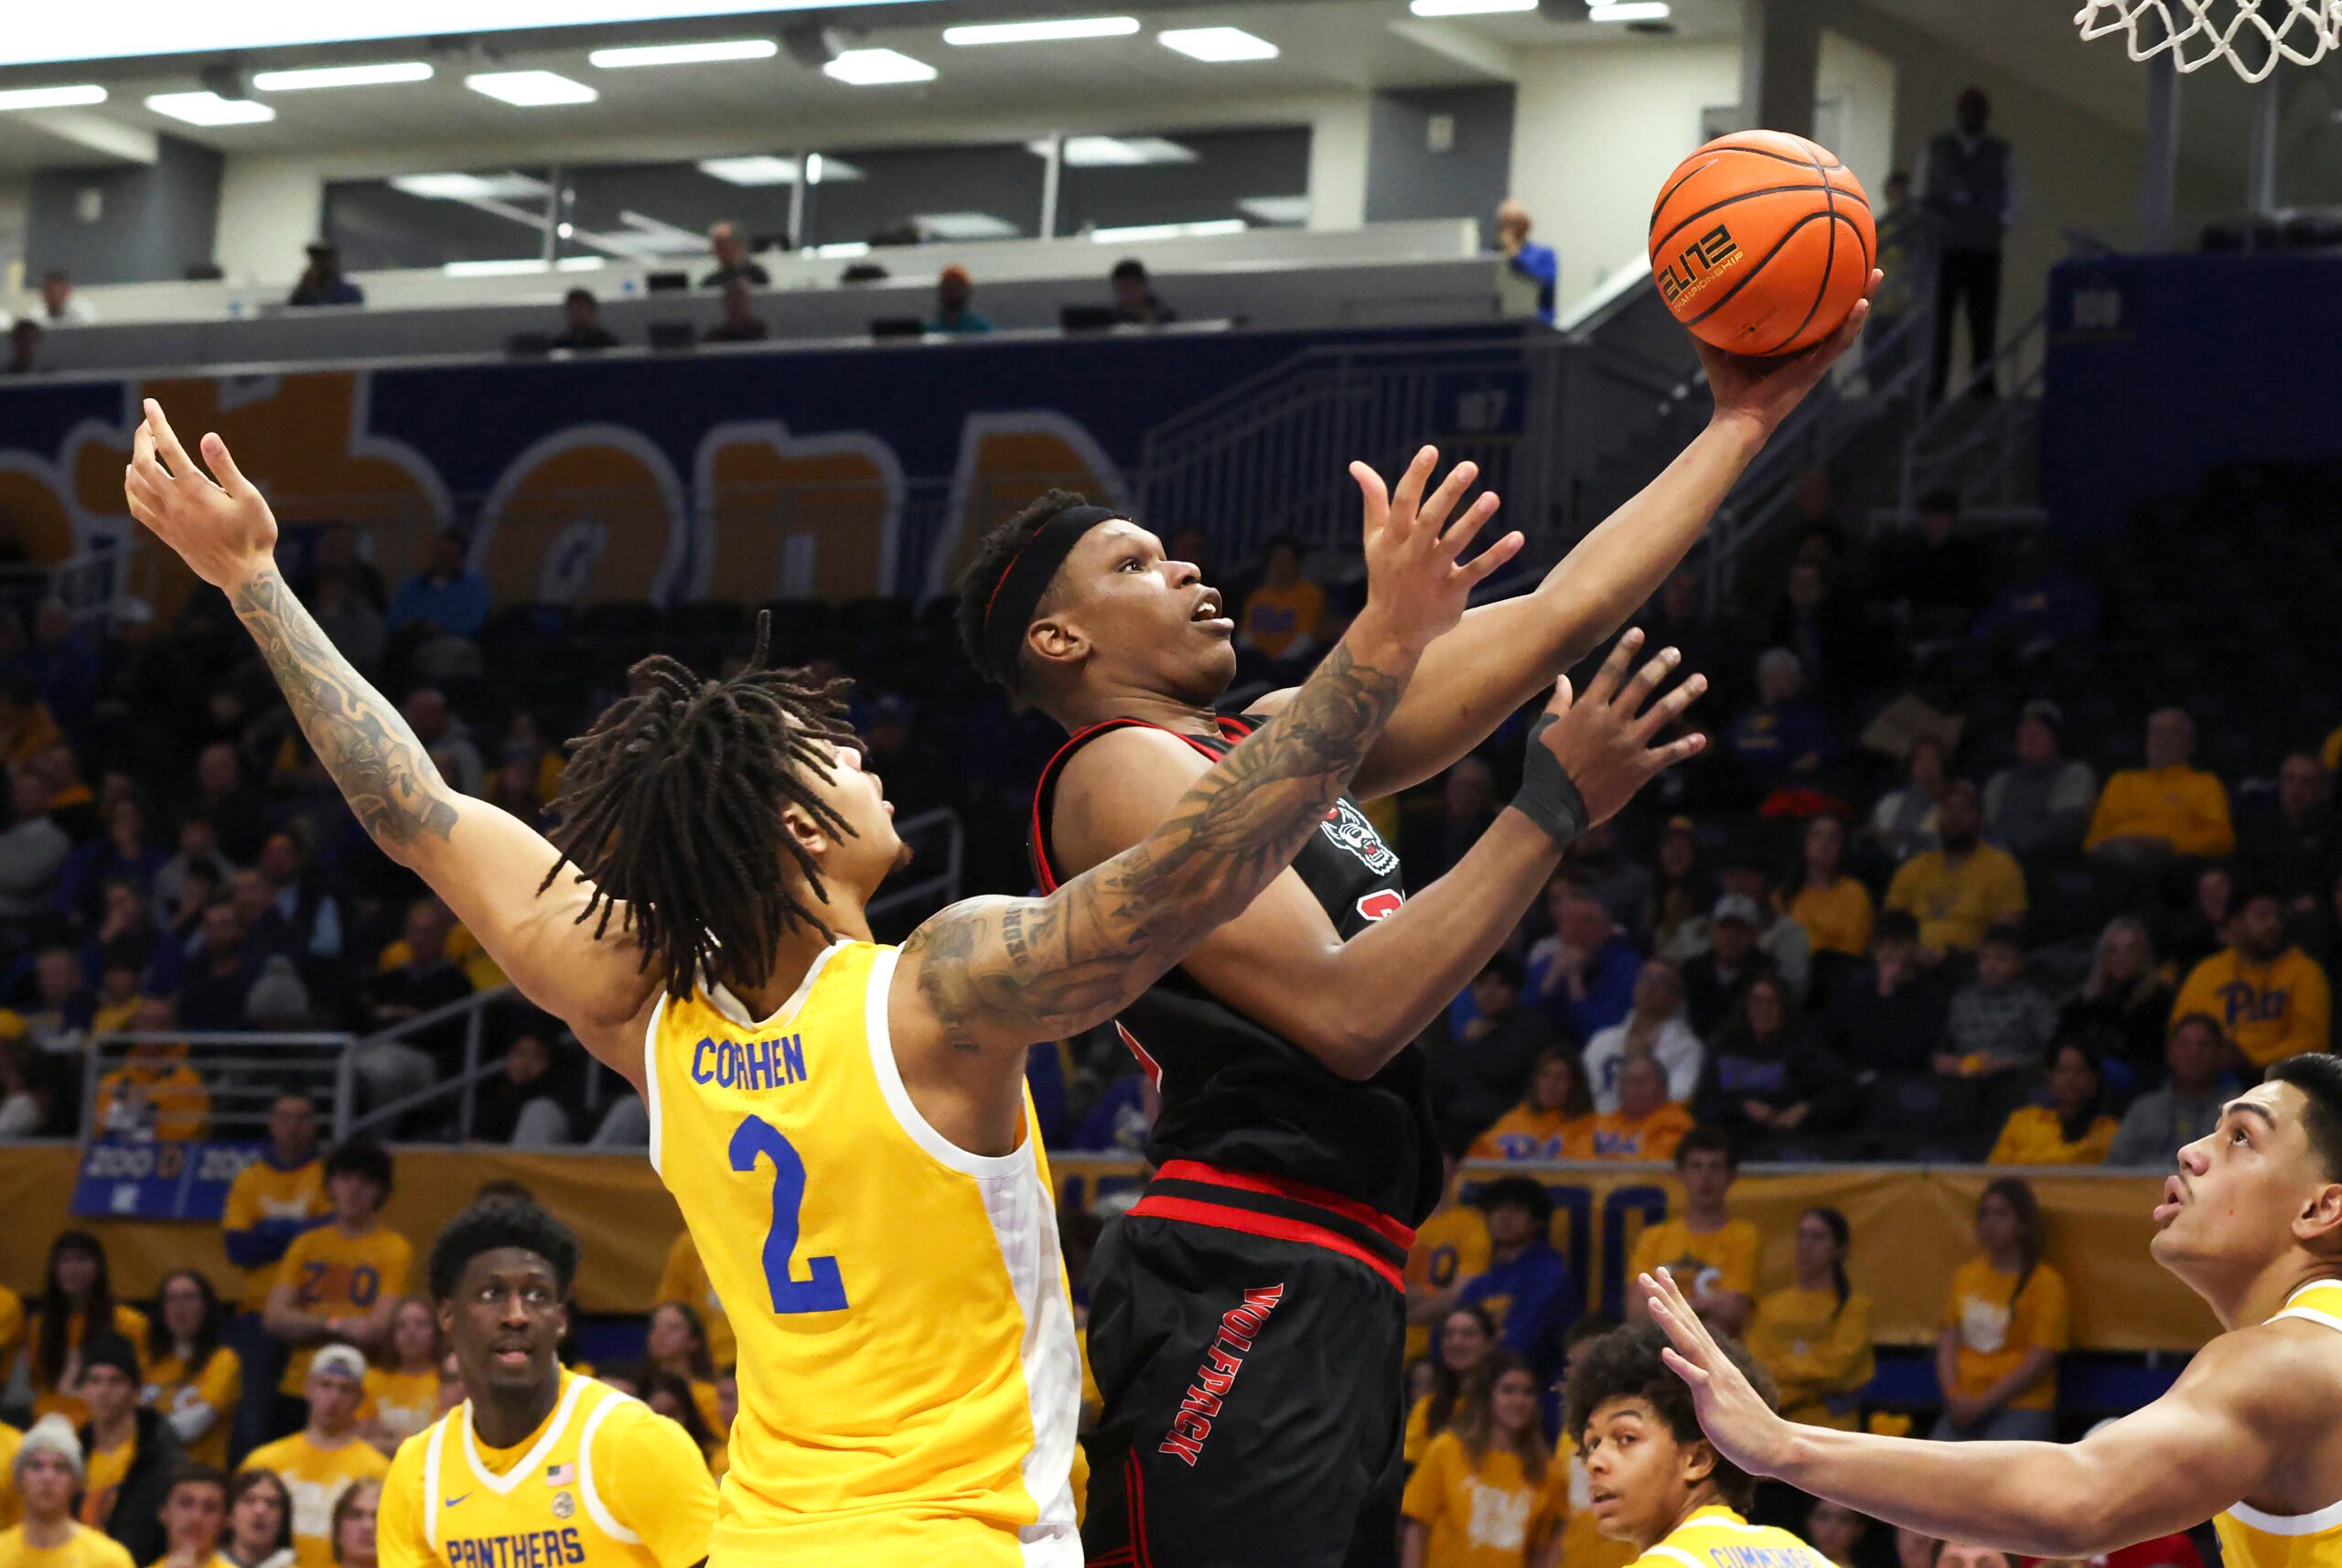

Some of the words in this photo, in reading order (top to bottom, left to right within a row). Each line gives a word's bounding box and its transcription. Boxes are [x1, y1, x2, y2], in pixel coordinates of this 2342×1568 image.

[728, 1114, 850, 1314] 2
[1158, 1283, 1284, 1467] WOLFPACK
[445, 1526, 586, 1568] PANTHERS
